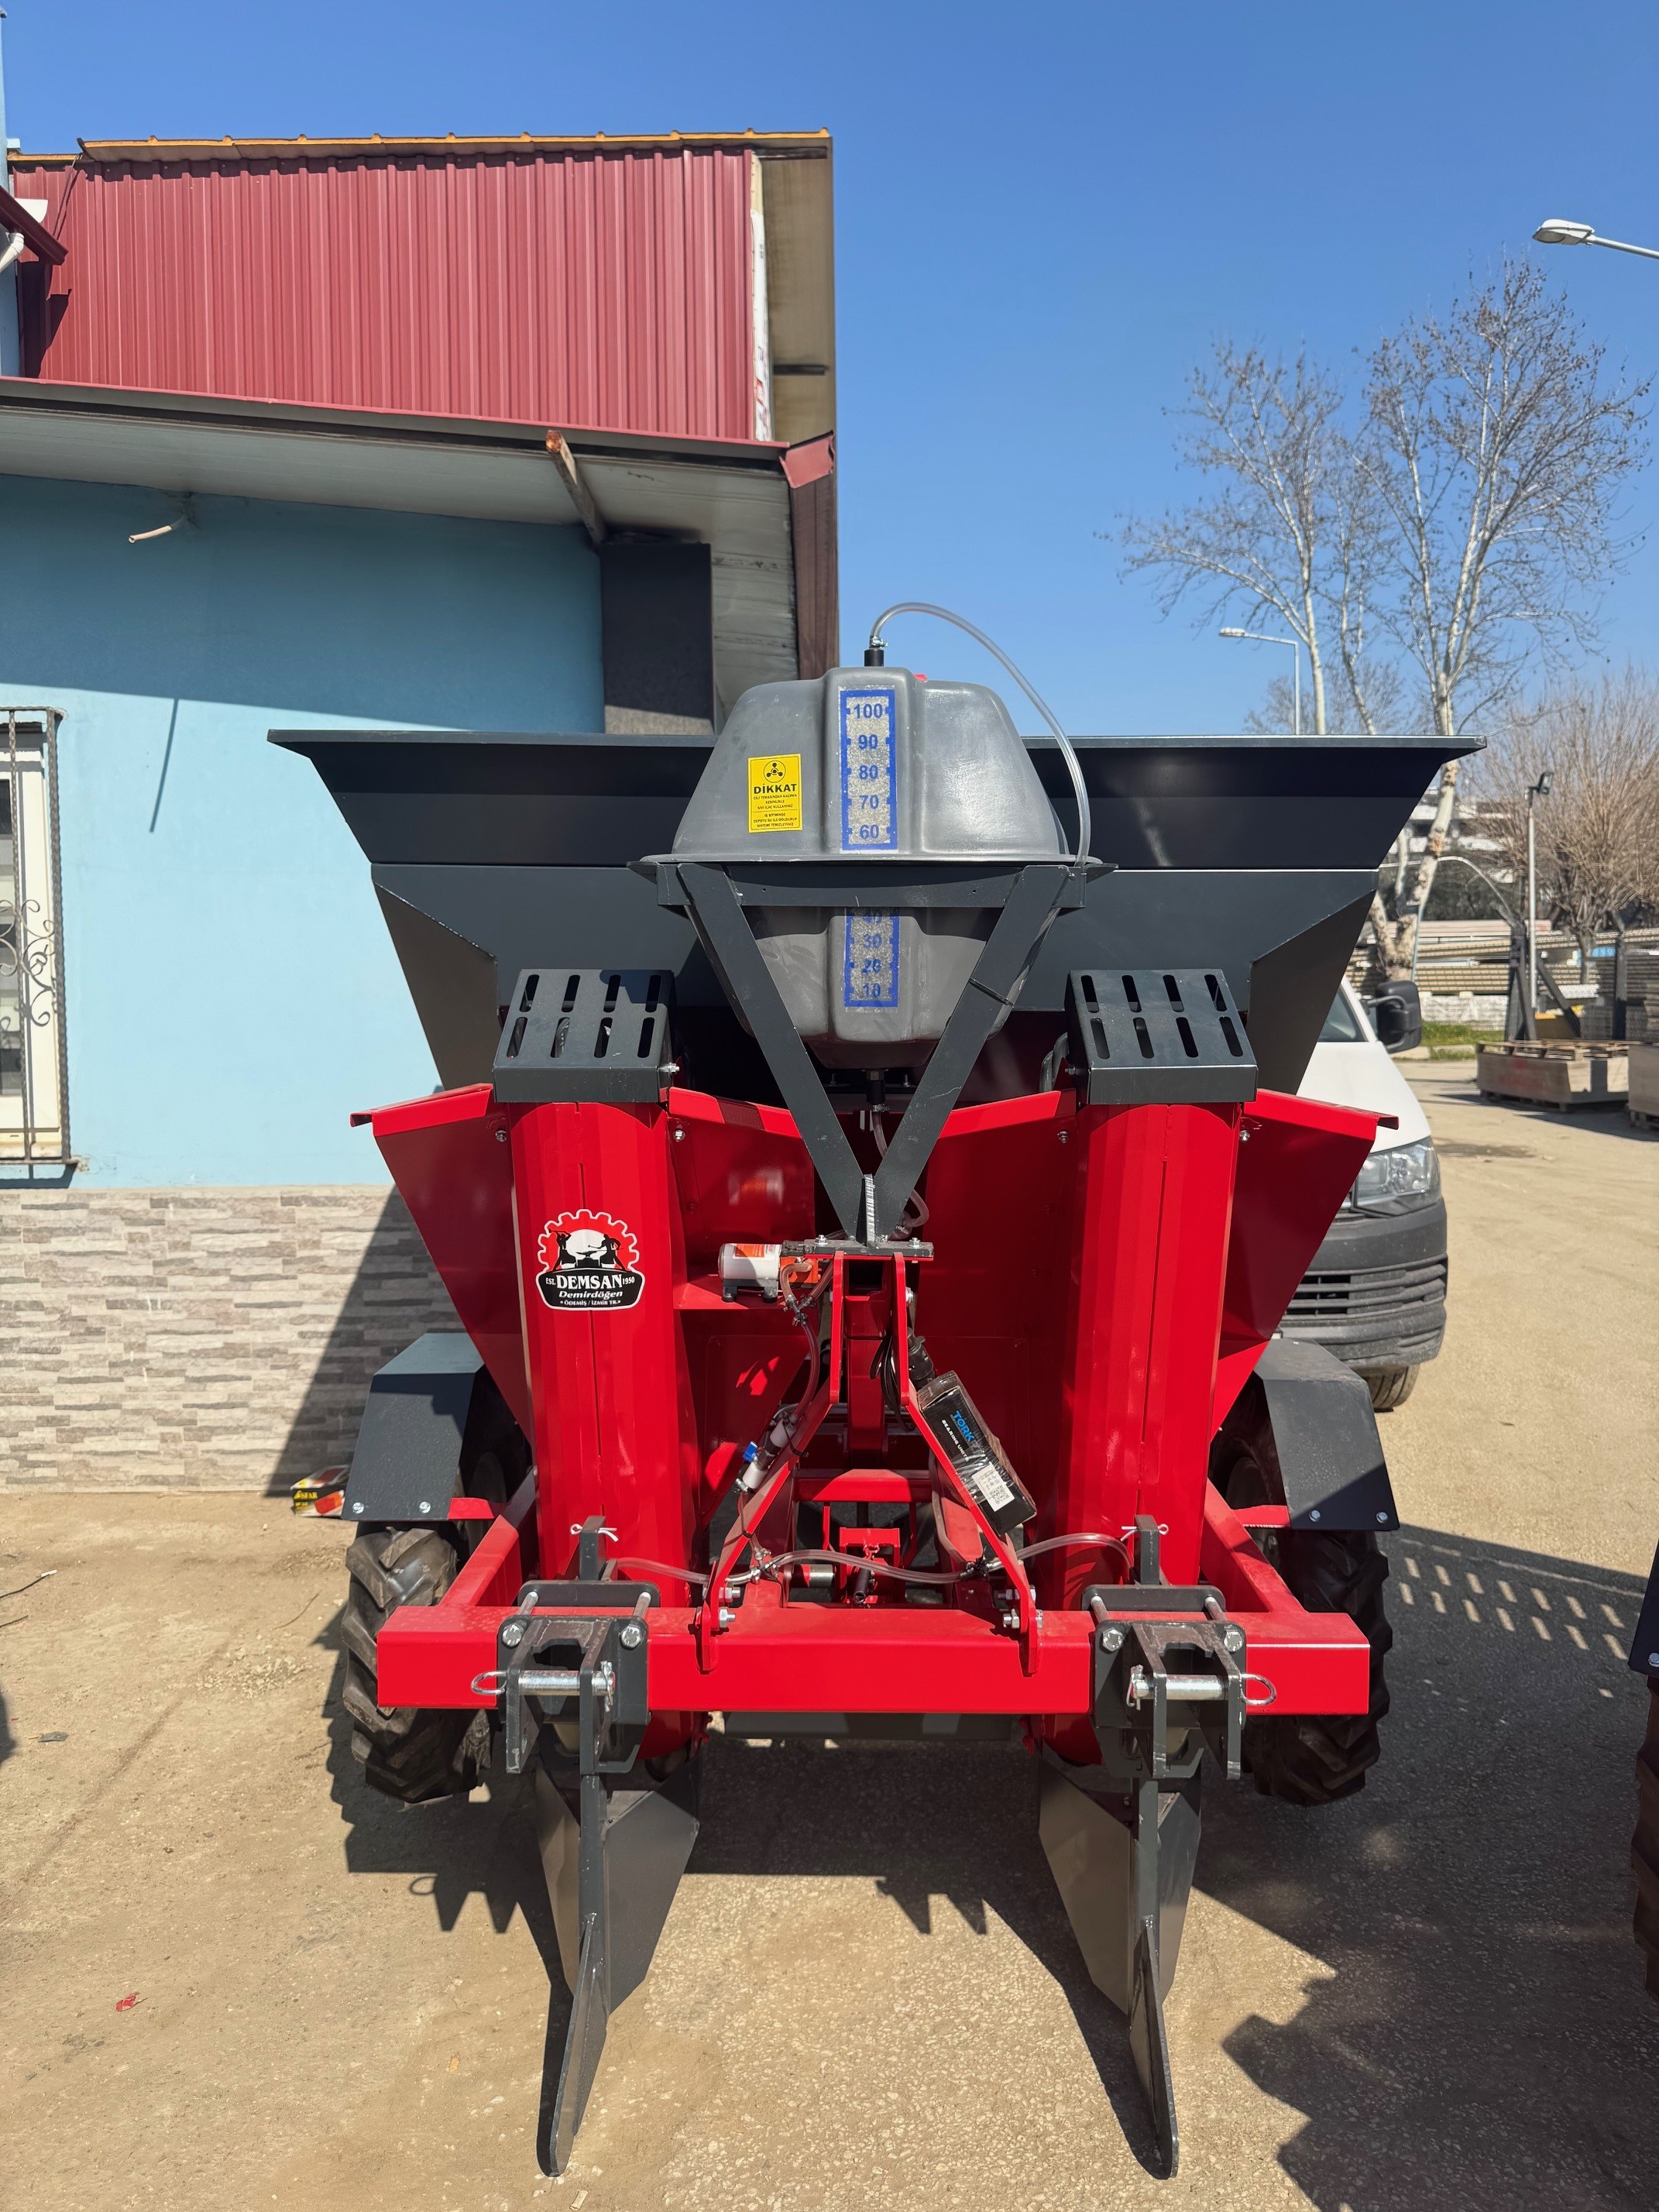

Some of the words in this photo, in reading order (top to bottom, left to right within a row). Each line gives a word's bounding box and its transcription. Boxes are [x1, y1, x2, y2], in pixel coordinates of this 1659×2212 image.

[854, 702, 883, 720] 100
[858, 734, 878, 750] 90
[859, 765, 879, 781] 80
[754, 783, 797, 794] DİKKAT
[859, 795, 879, 810] 70
[860, 824, 880, 840] 60
[863, 933, 882, 949] 30
[860, 959, 882, 974] 20
[863, 983, 881, 998] 10
[545, 1277, 556, 1286] EST.
[556, 1274, 623, 1290] DEMSAN
[623, 1276, 635, 1285] 1950
[558, 1290, 623, 1300] Demirdöğen
[942, 1419, 959, 1445] BEARING
[953, 1410, 974, 1442] TORK
